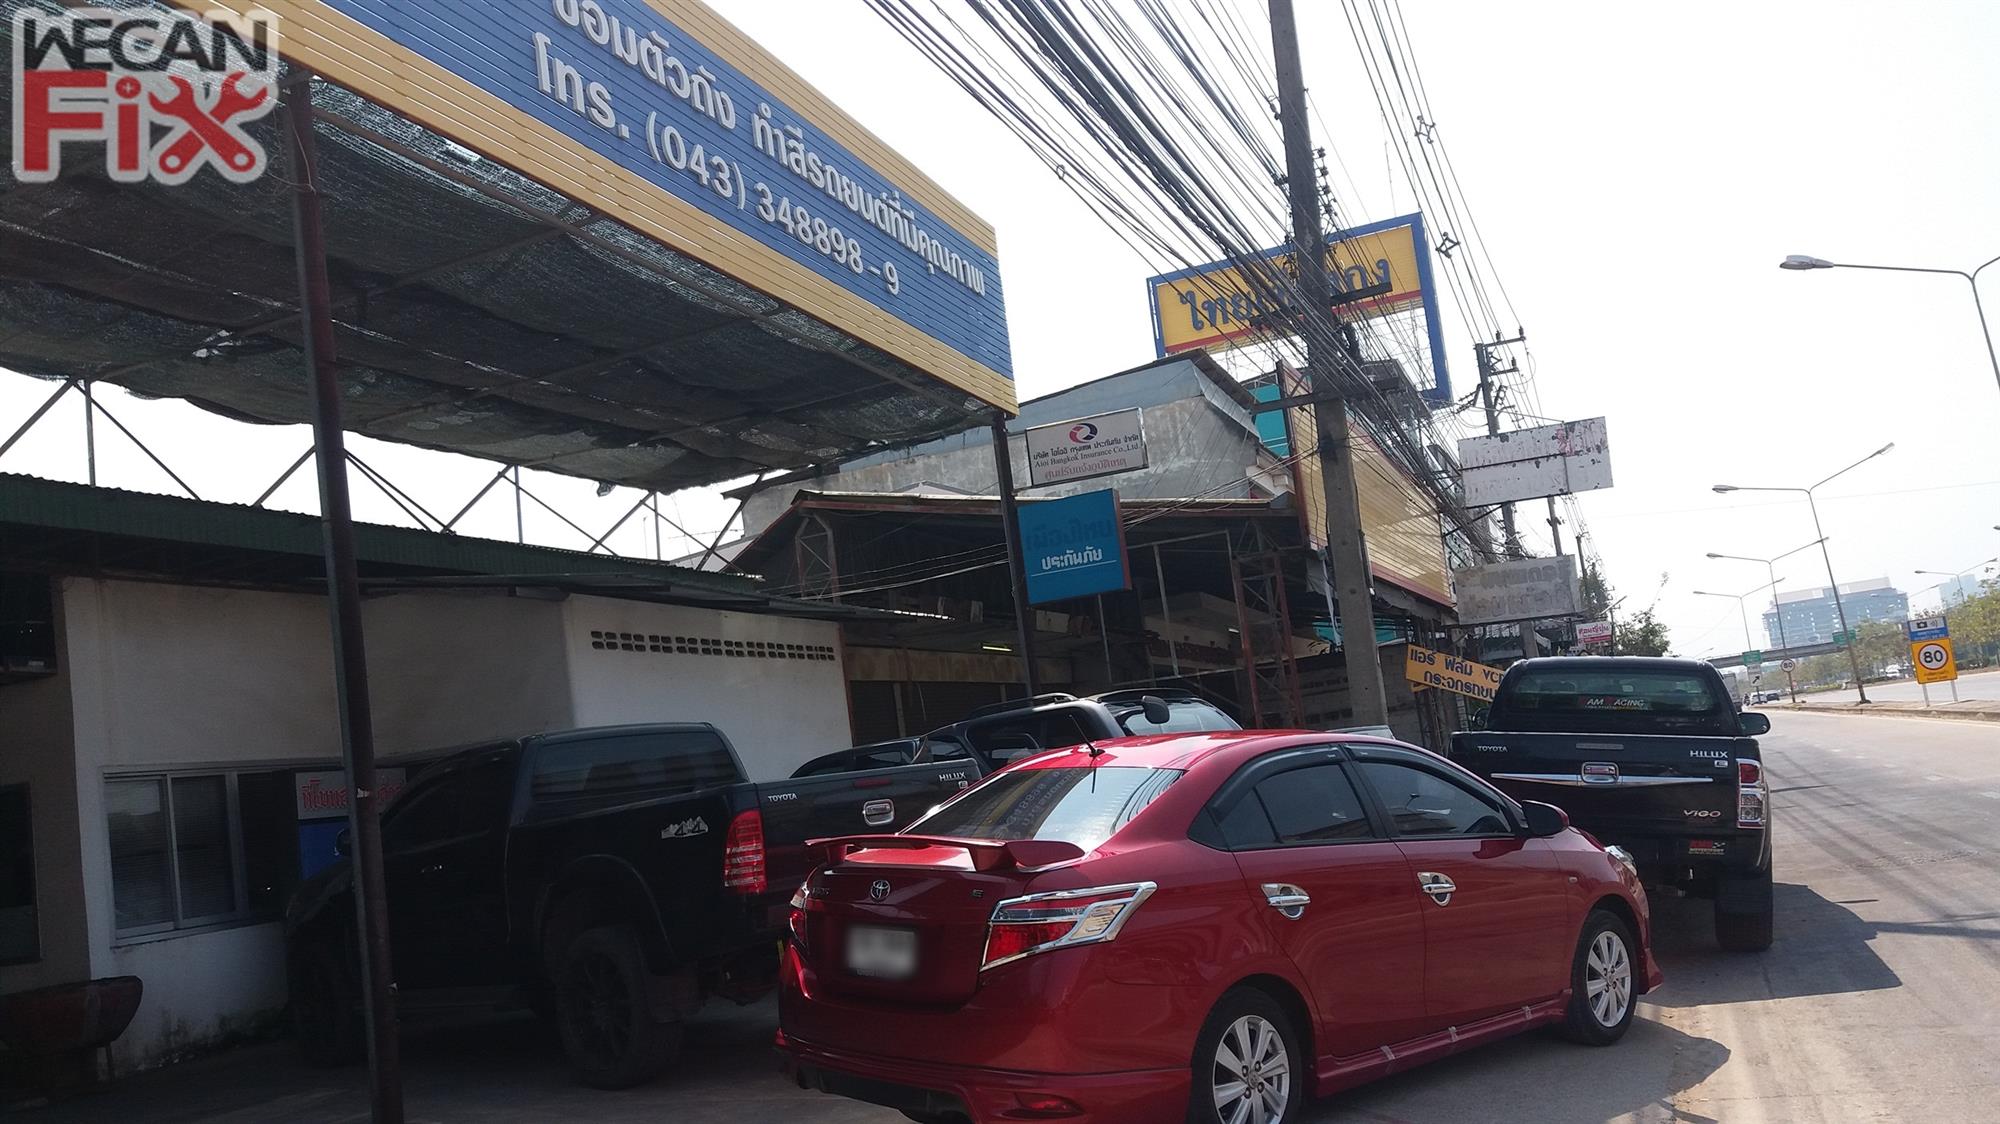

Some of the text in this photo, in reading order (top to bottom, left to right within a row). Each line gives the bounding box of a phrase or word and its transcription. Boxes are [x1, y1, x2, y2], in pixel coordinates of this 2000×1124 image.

[532, 31, 900, 296] โทร. (043) 348898-9
[752, 102, 986, 297] ทำสีรถยนต์ที่มีคุณภาพ
[1034, 459, 1050, 469] Aioi
[1050, 453, 1080, 466] Bangkok
[1080, 447, 1113, 460] Insurance
[1041, 545, 1104, 570] ประกันภัย
[1923, 649, 1944, 664] 80
[1783, 661, 1793, 669] 80
[1477, 745, 1508, 753] TOYOTA
[1689, 750, 1729, 759] HILUX
[938, 771, 967, 782] HILUX
[767, 792, 798, 803] TOYOTA
